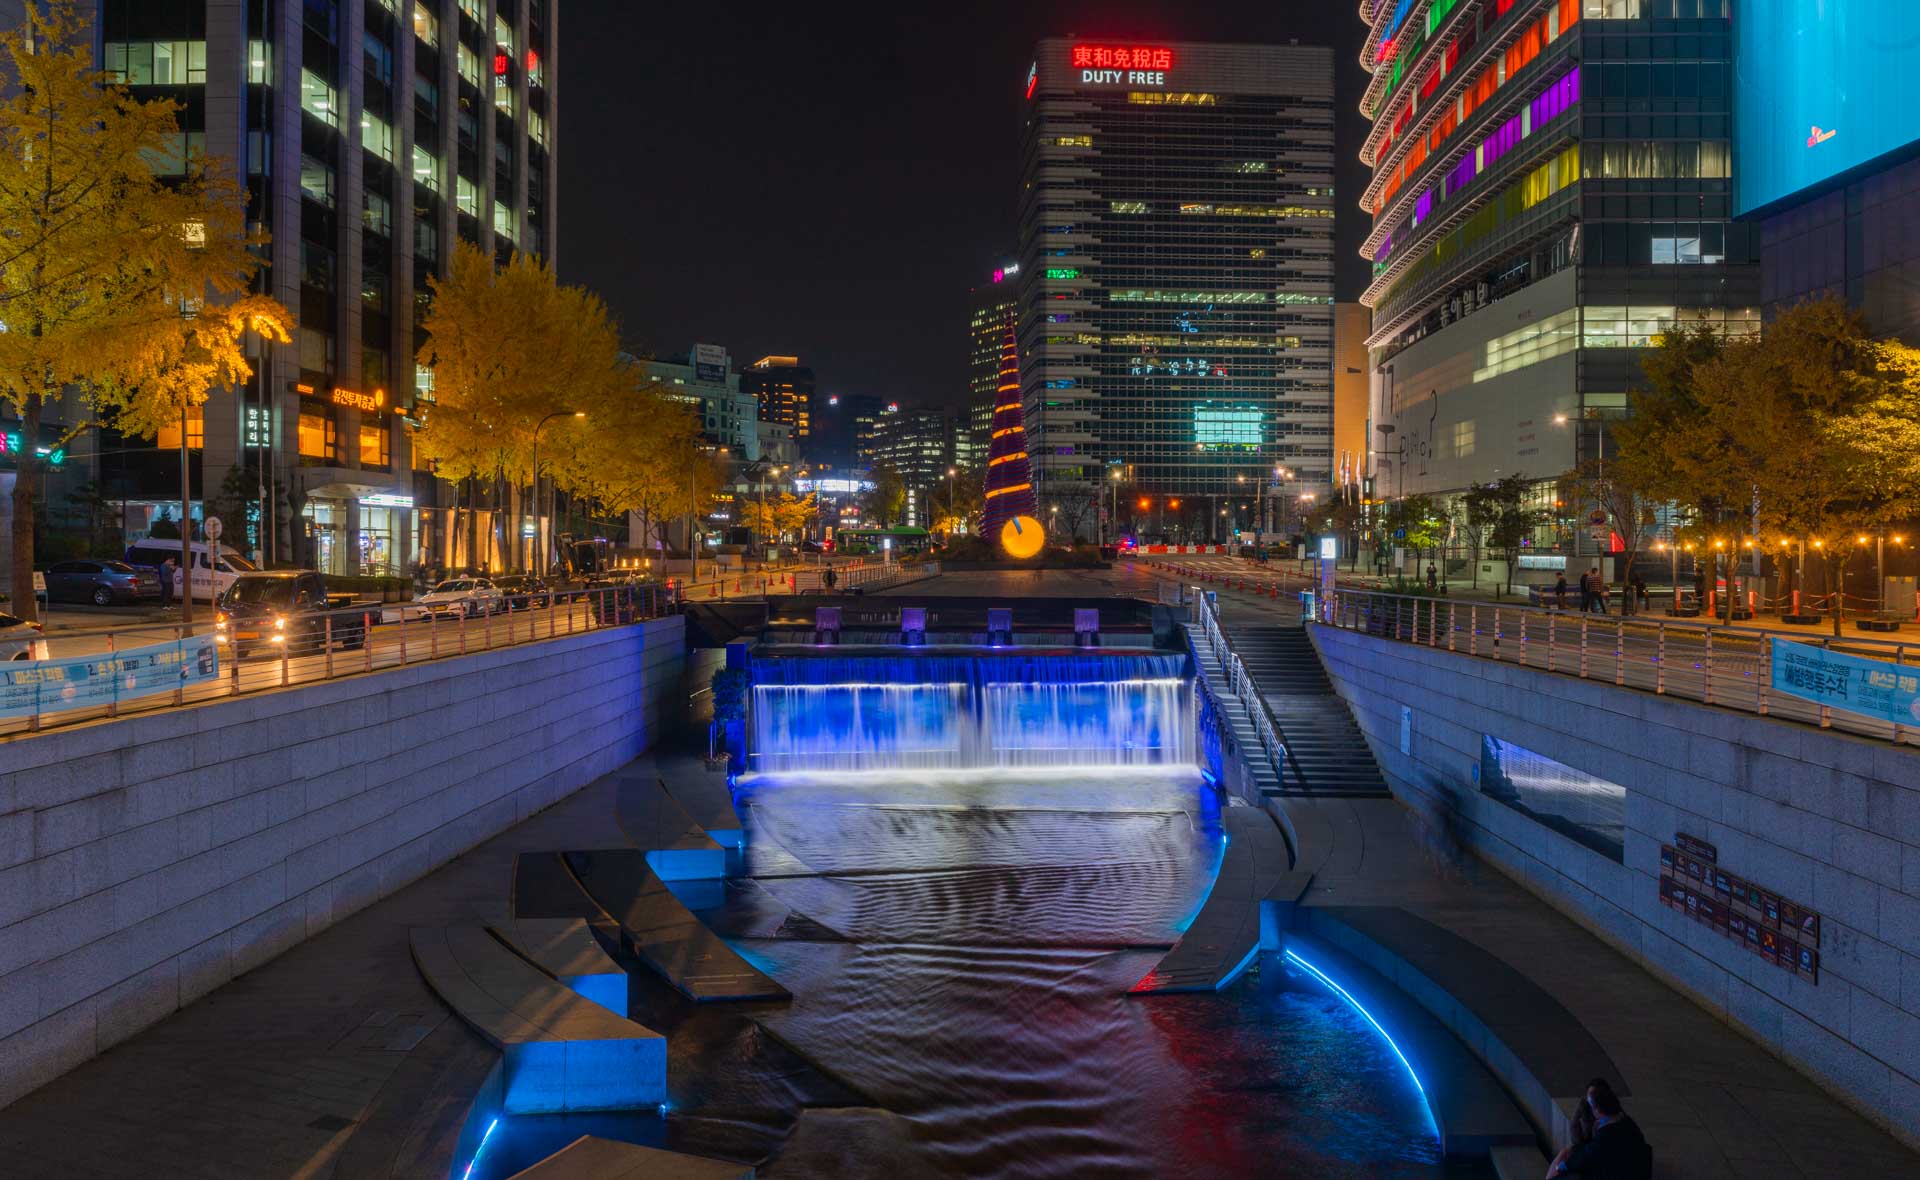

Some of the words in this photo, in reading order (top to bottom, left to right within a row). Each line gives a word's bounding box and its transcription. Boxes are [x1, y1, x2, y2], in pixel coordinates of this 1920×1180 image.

[1082, 70, 1122, 84] DUTY
[1129, 71, 1164, 85] FREE
[333, 388, 376, 411] 유진투자증권
[1784, 664, 1848, 700] 예방행동수칙
[1869, 670, 1897, 689] 마스크
